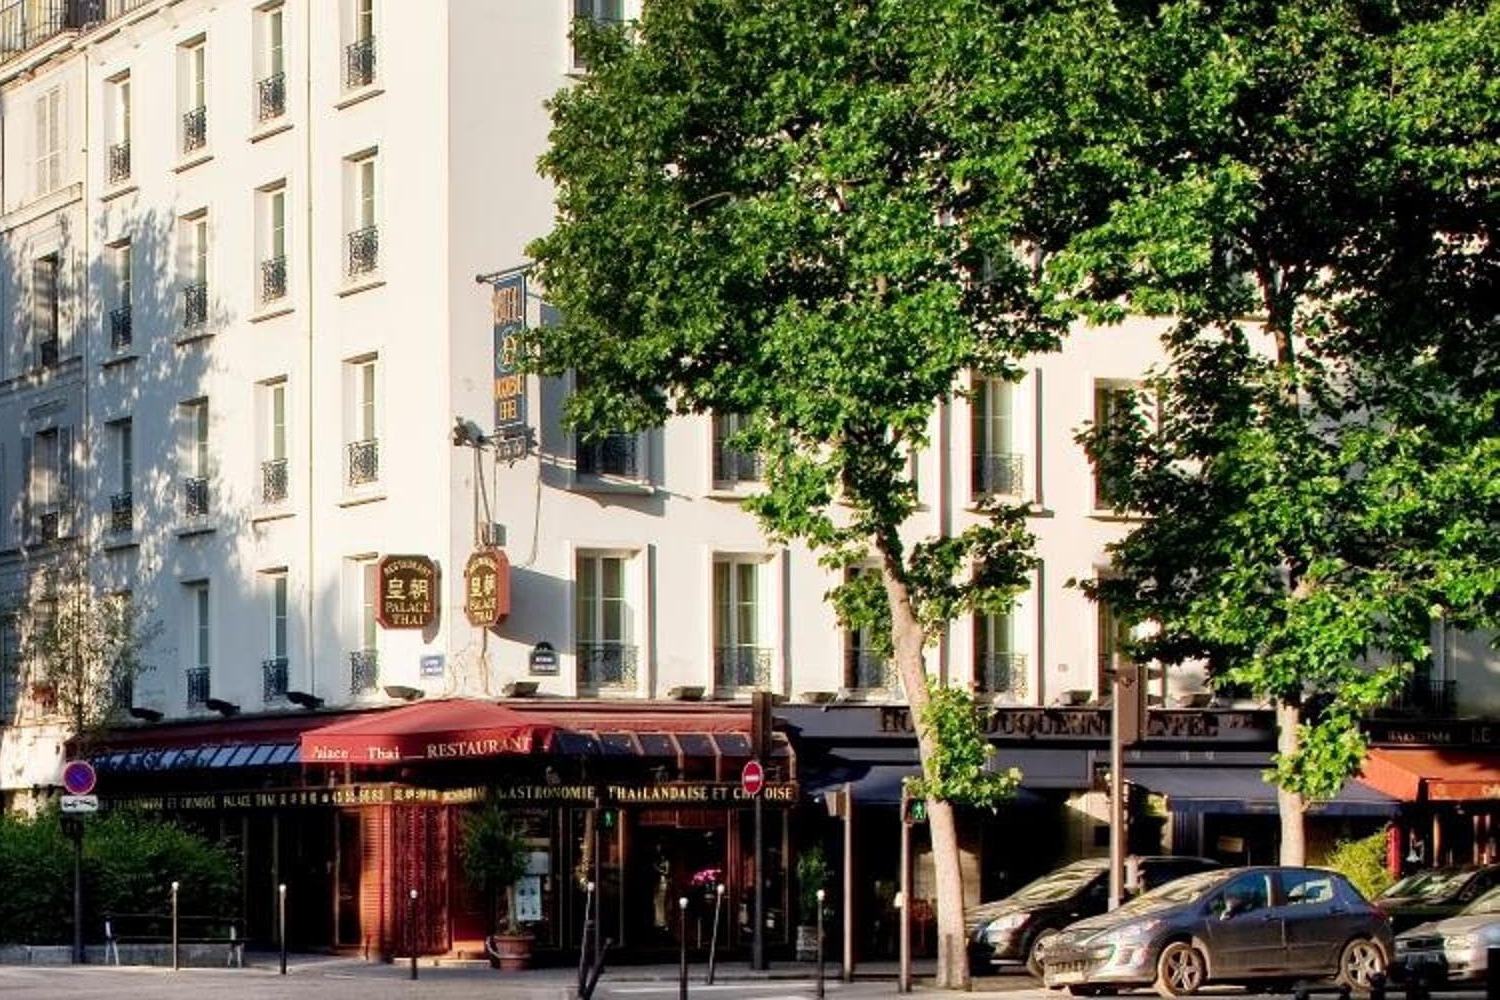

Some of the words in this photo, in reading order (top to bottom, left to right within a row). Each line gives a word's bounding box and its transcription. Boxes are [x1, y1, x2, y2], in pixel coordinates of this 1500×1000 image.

[386, 602, 431, 613] PALACE
[391, 614, 424, 625] THAI
[367, 745, 400, 760] Thai
[426, 736, 533, 759] RESTAURANT
[711, 786, 729, 800] ET
[733, 786, 793, 801] COISE
